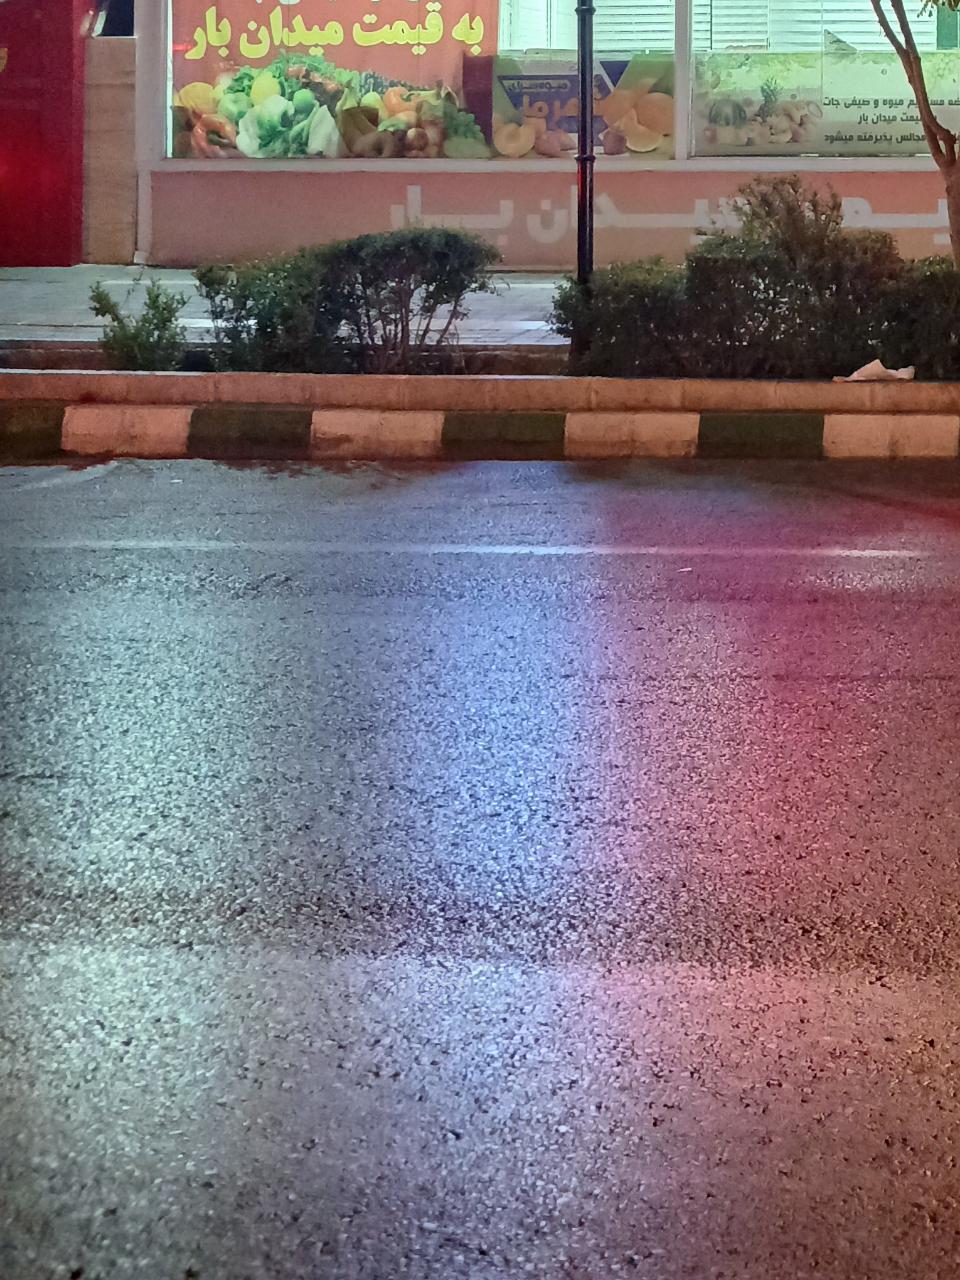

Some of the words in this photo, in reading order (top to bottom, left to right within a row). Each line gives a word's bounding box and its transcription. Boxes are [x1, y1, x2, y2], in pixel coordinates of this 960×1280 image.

[184, 5, 232, 60] بار
[239, 5, 345, 58] میدان
[352, 1, 444, 55] قیمت
[451, 12, 485, 55] به
[823, 96, 840, 108] جات
[843, 95, 871, 109] صیفی
[873, 98, 879, 109] و
[882, 97, 904, 109] میوه
[857, 112, 869, 125] بار
[871, 112, 898, 125] میدان
[900, 112, 921, 125] یمت
[824, 130, 854, 144] میشود
